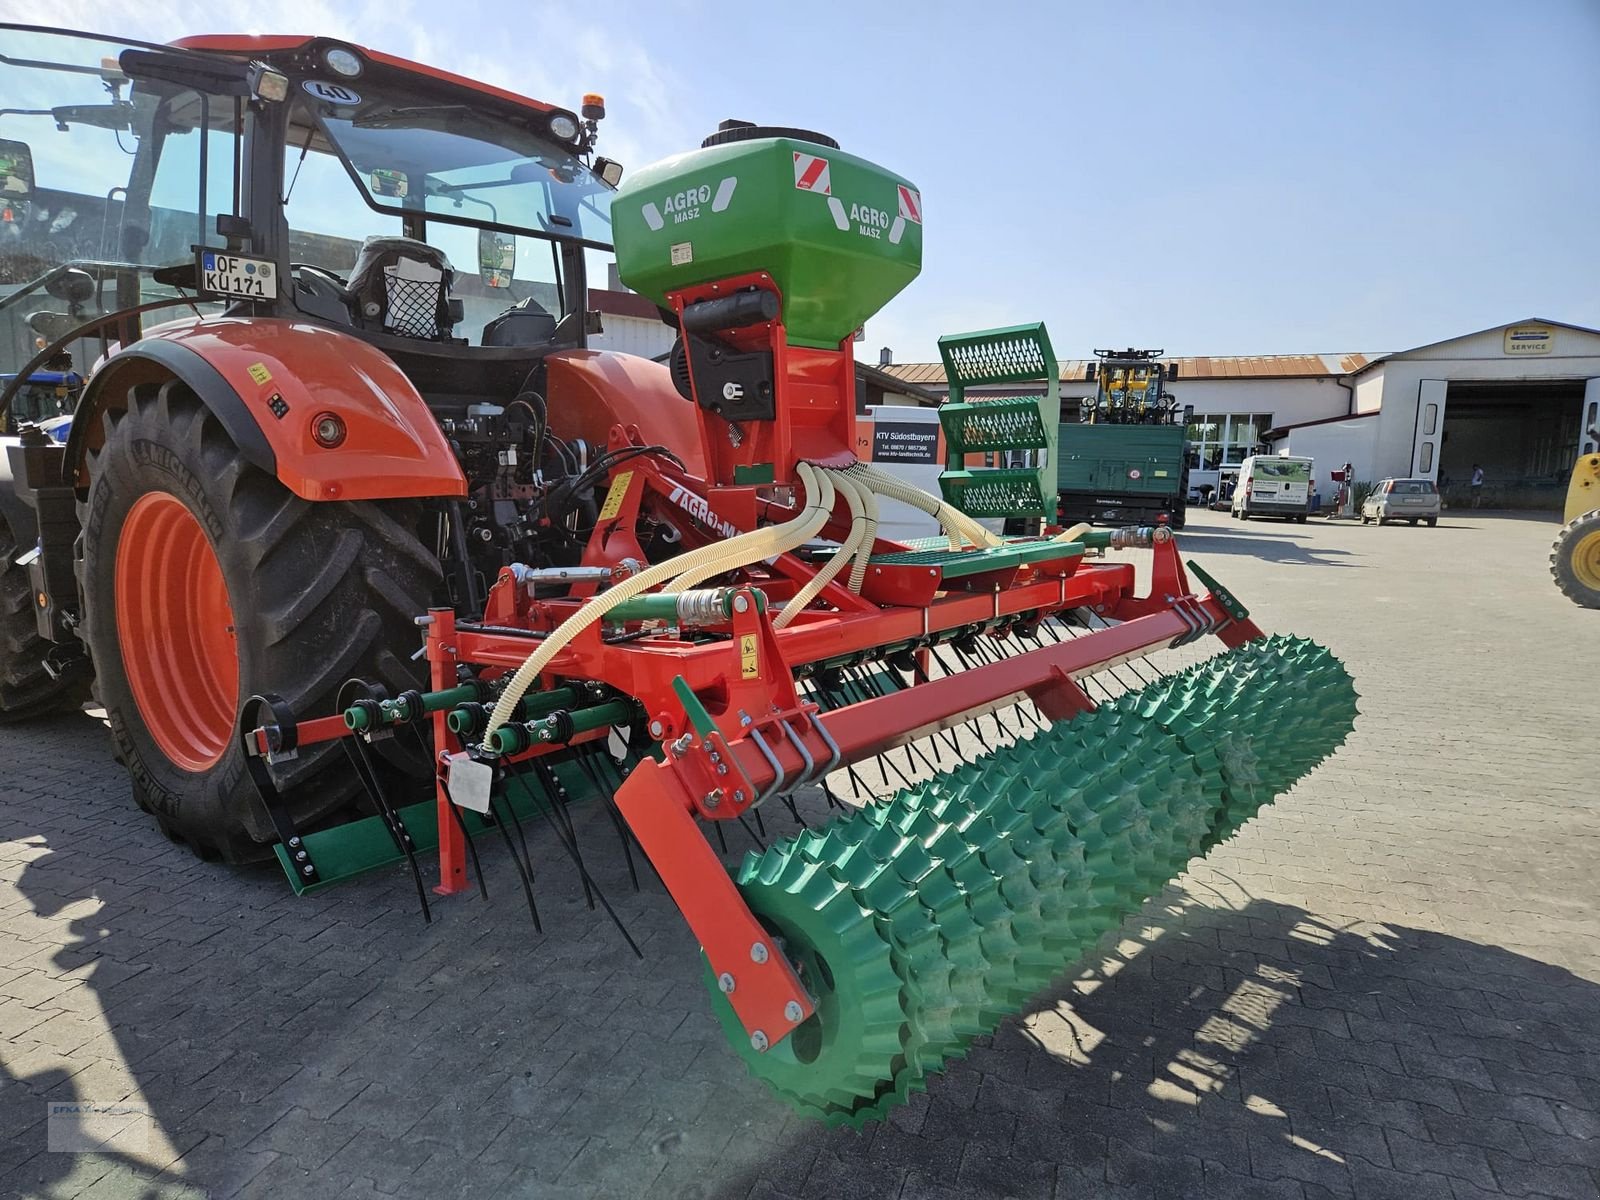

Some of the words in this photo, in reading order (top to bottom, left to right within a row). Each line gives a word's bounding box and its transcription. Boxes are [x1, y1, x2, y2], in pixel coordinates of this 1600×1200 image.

[315, 83, 352, 101] 40
[663, 184, 711, 215] AGRO
[674, 207, 700, 224] MASZ
[850, 203, 889, 229] AGRO
[859, 224, 881, 239] MASZ
[217, 256, 239, 274] OF
[876, 431, 890, 440] KTV
[890, 432, 936, 443] Südostbayern
[679, 492, 745, 539] AGRO-M
